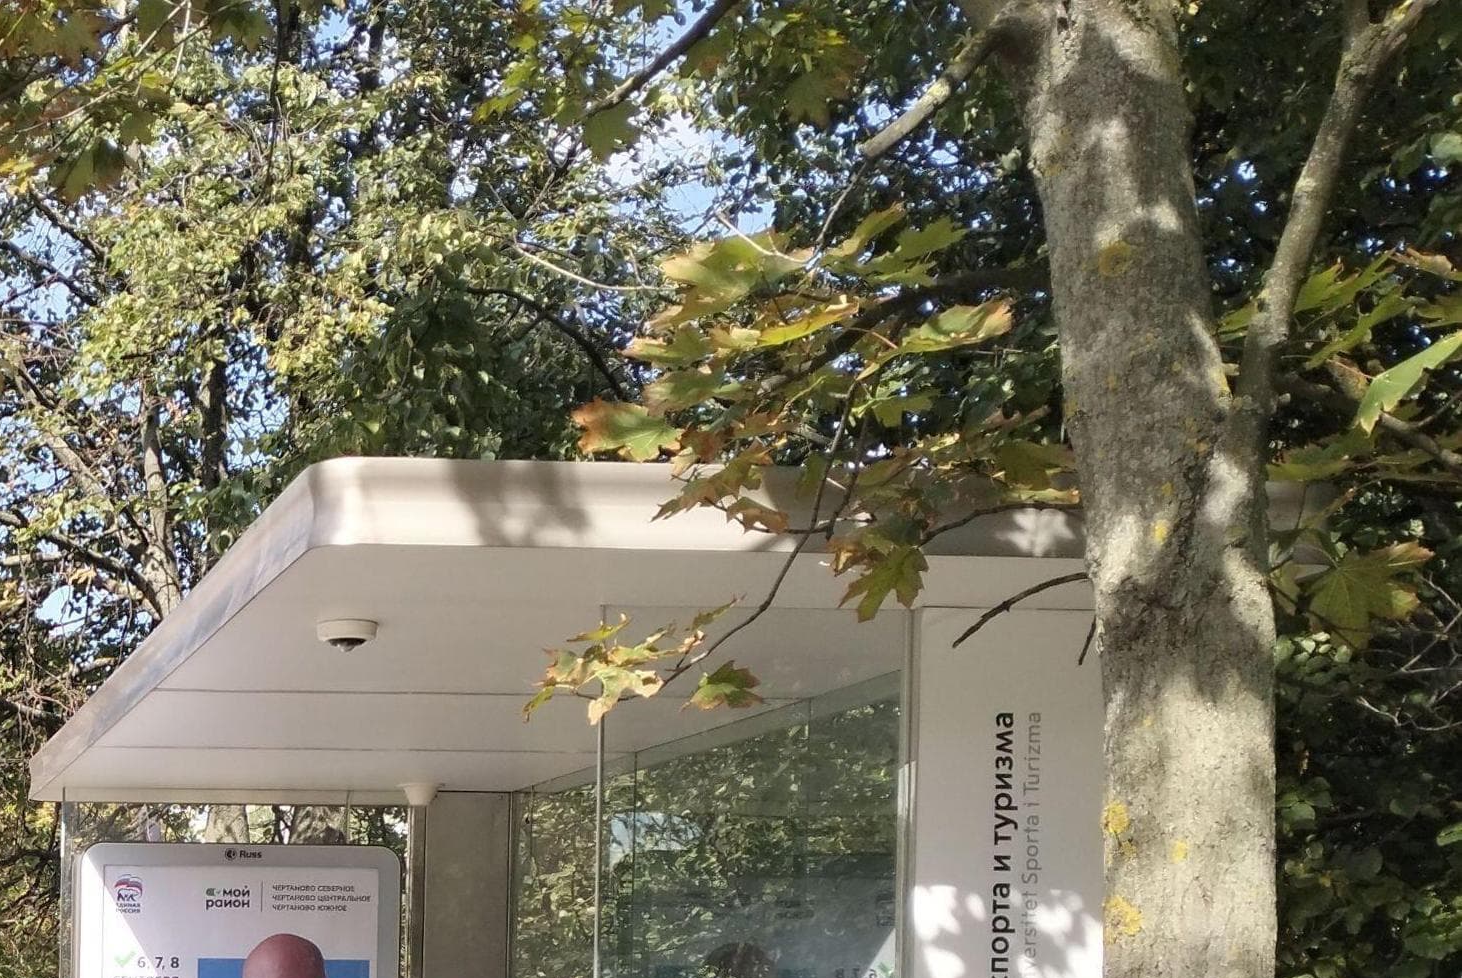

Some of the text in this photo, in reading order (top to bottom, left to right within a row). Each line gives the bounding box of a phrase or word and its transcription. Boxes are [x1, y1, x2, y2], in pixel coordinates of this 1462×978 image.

[1022, 711, 1042, 794] Turizma
[994, 711, 1019, 846] туризма
[239, 850, 262, 859] Russ
[1022, 814, 1043, 884] Sporta
[993, 854, 1012, 872] и
[317, 885, 355, 893] СЕВЕРНОЕ
[272, 894, 316, 902] ЧЕРТАНОВО
[272, 904, 316, 912] ЧЕРТАНОВО
[137, 956, 180, 970] 6, 7, 8
